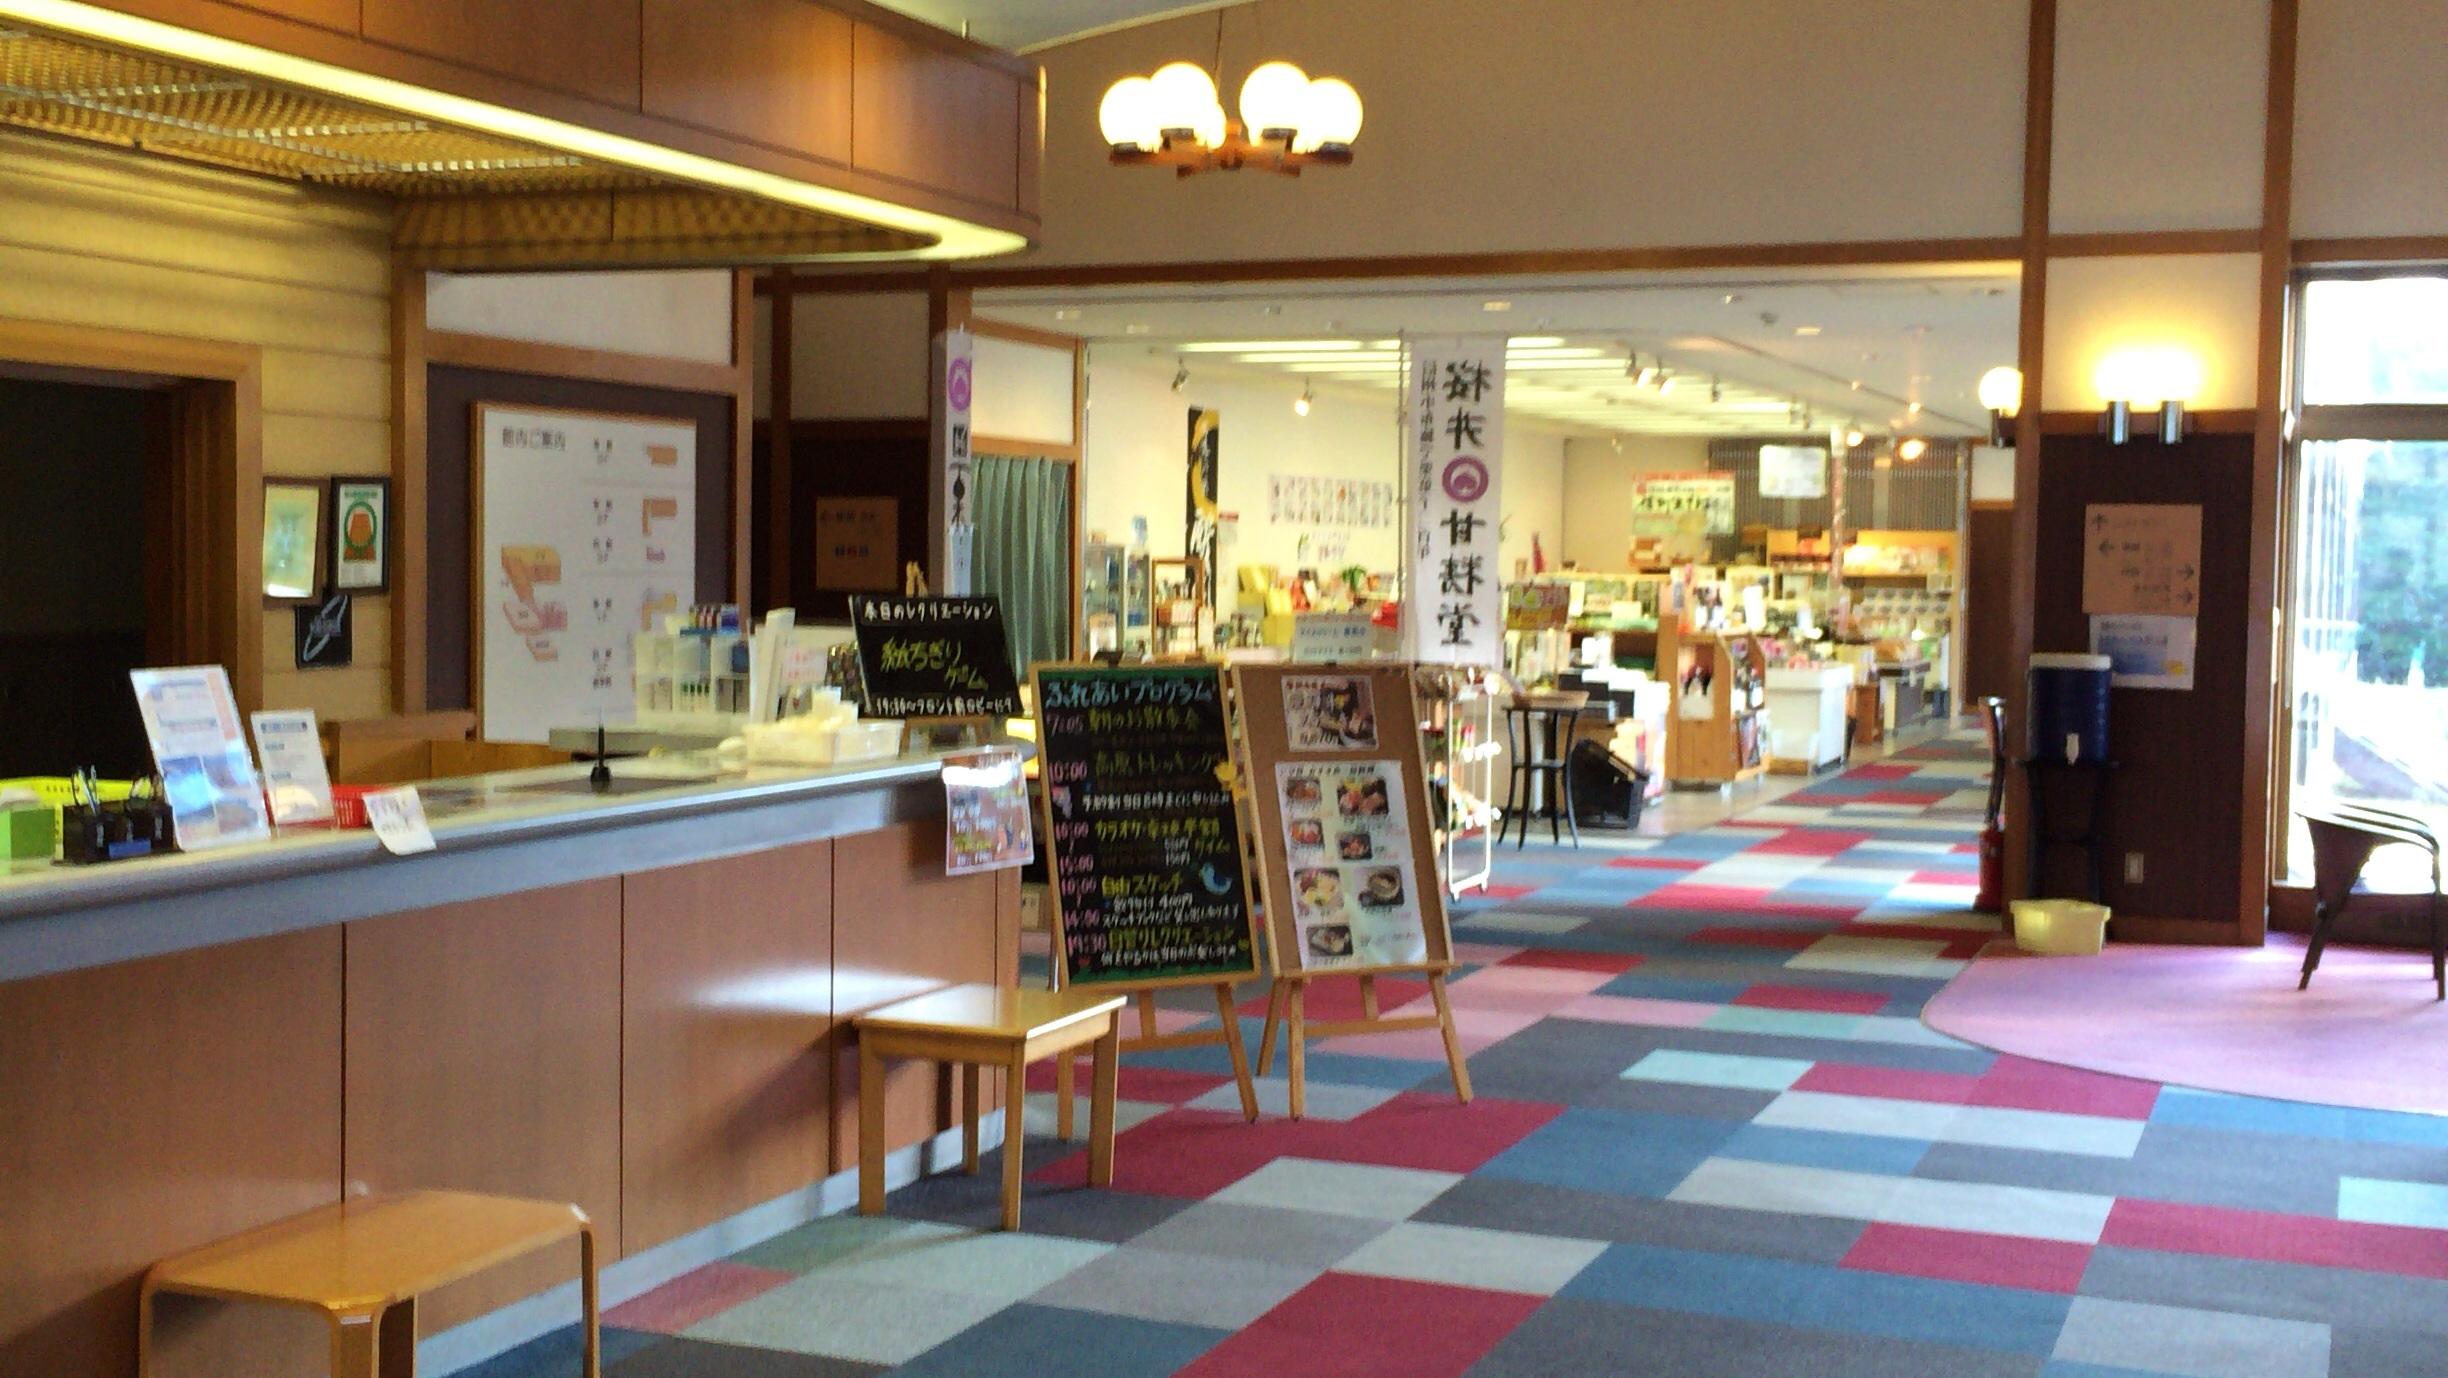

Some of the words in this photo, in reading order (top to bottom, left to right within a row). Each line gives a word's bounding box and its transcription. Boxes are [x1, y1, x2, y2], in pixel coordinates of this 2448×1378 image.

[1045, 678, 1217, 708] ふれあいプログラム
